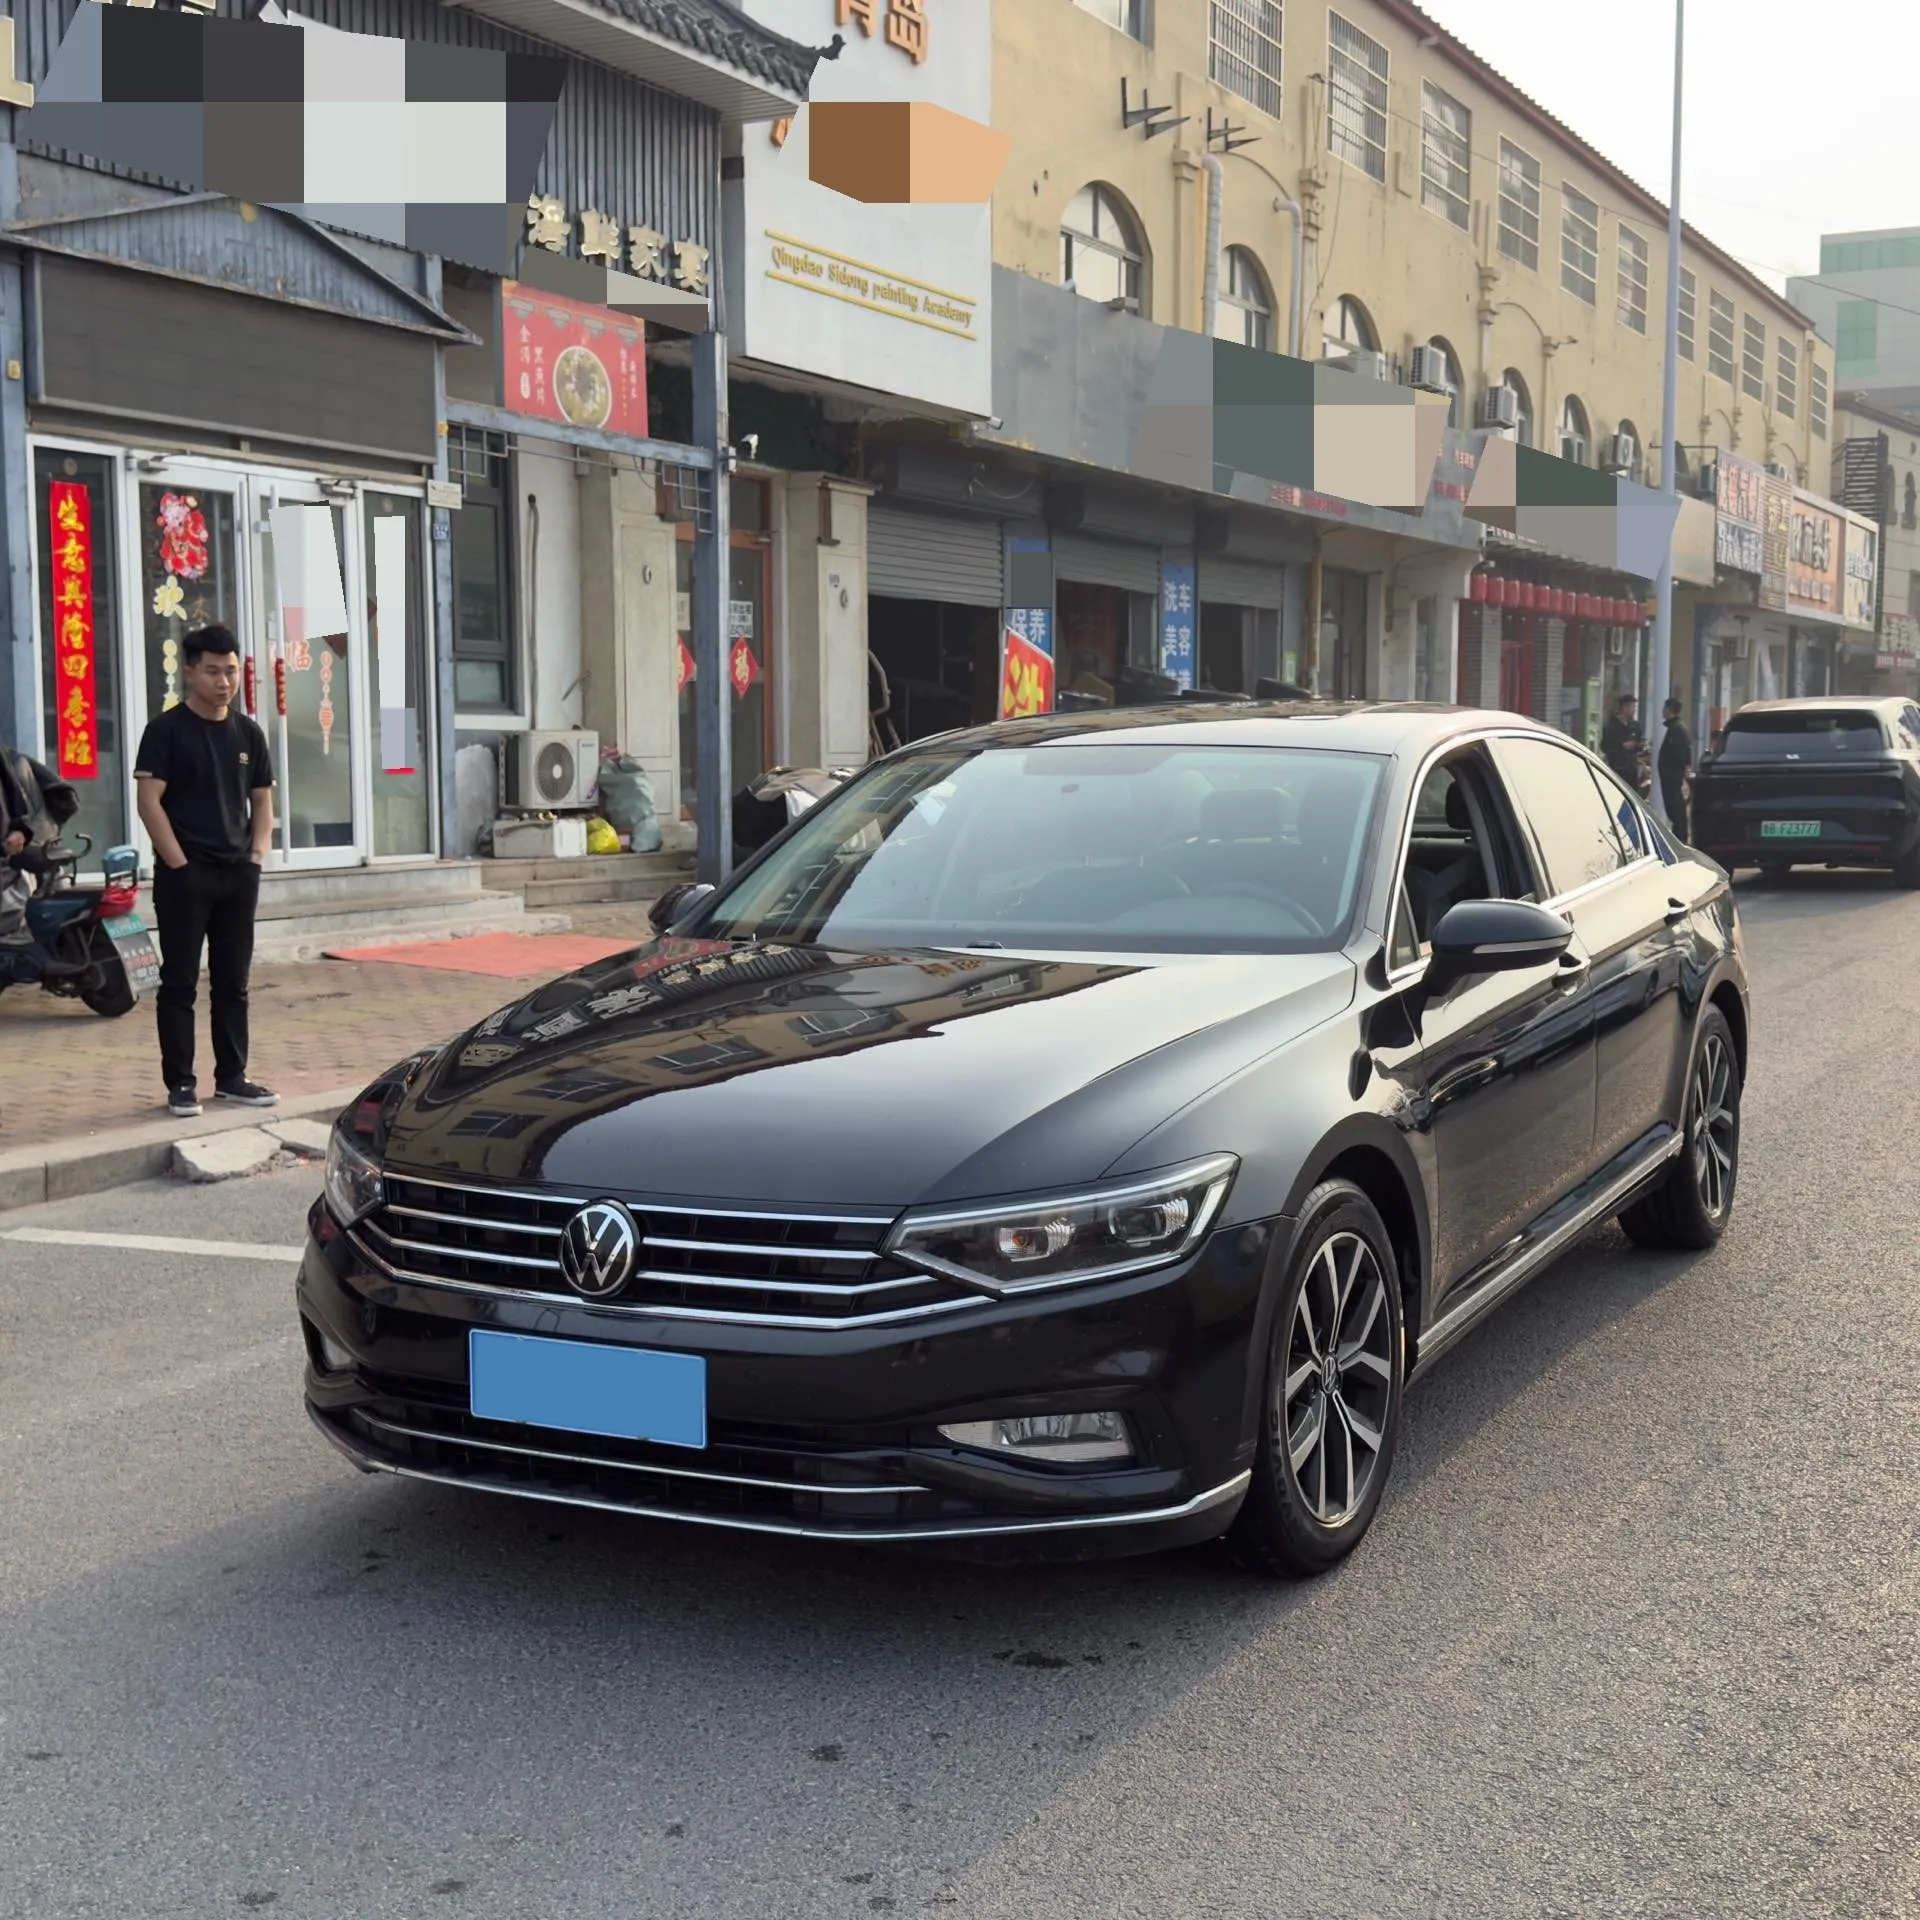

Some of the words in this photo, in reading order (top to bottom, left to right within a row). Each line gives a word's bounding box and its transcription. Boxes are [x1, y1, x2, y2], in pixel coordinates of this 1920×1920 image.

[771, 246, 824, 275] Qingdao
[828, 263, 870, 295] Sidong
[872, 281, 919, 312] painting
[923, 295, 973, 328] Academy
[1164, 581, 1192, 614] 洗车
[1164, 624, 1192, 657] 美容
